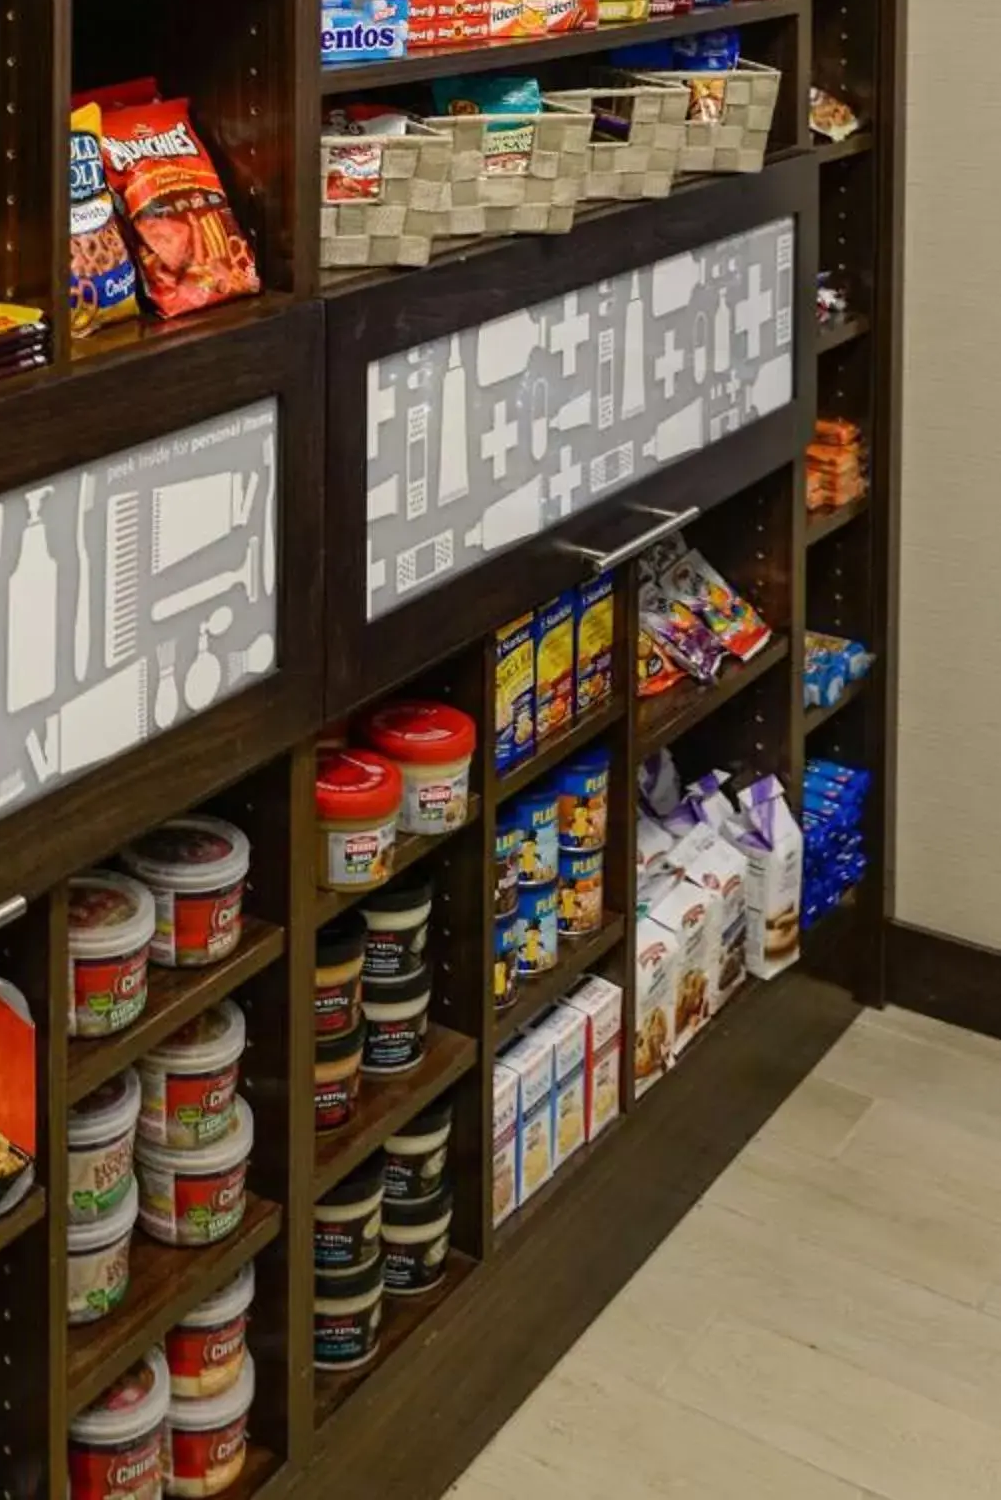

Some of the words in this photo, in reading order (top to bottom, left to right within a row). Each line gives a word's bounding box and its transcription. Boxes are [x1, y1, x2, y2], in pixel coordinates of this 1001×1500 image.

[492, 3, 524, 24] ident
[321, 24, 394, 50] entos
[101, 122, 198, 172] MUNCHIES
